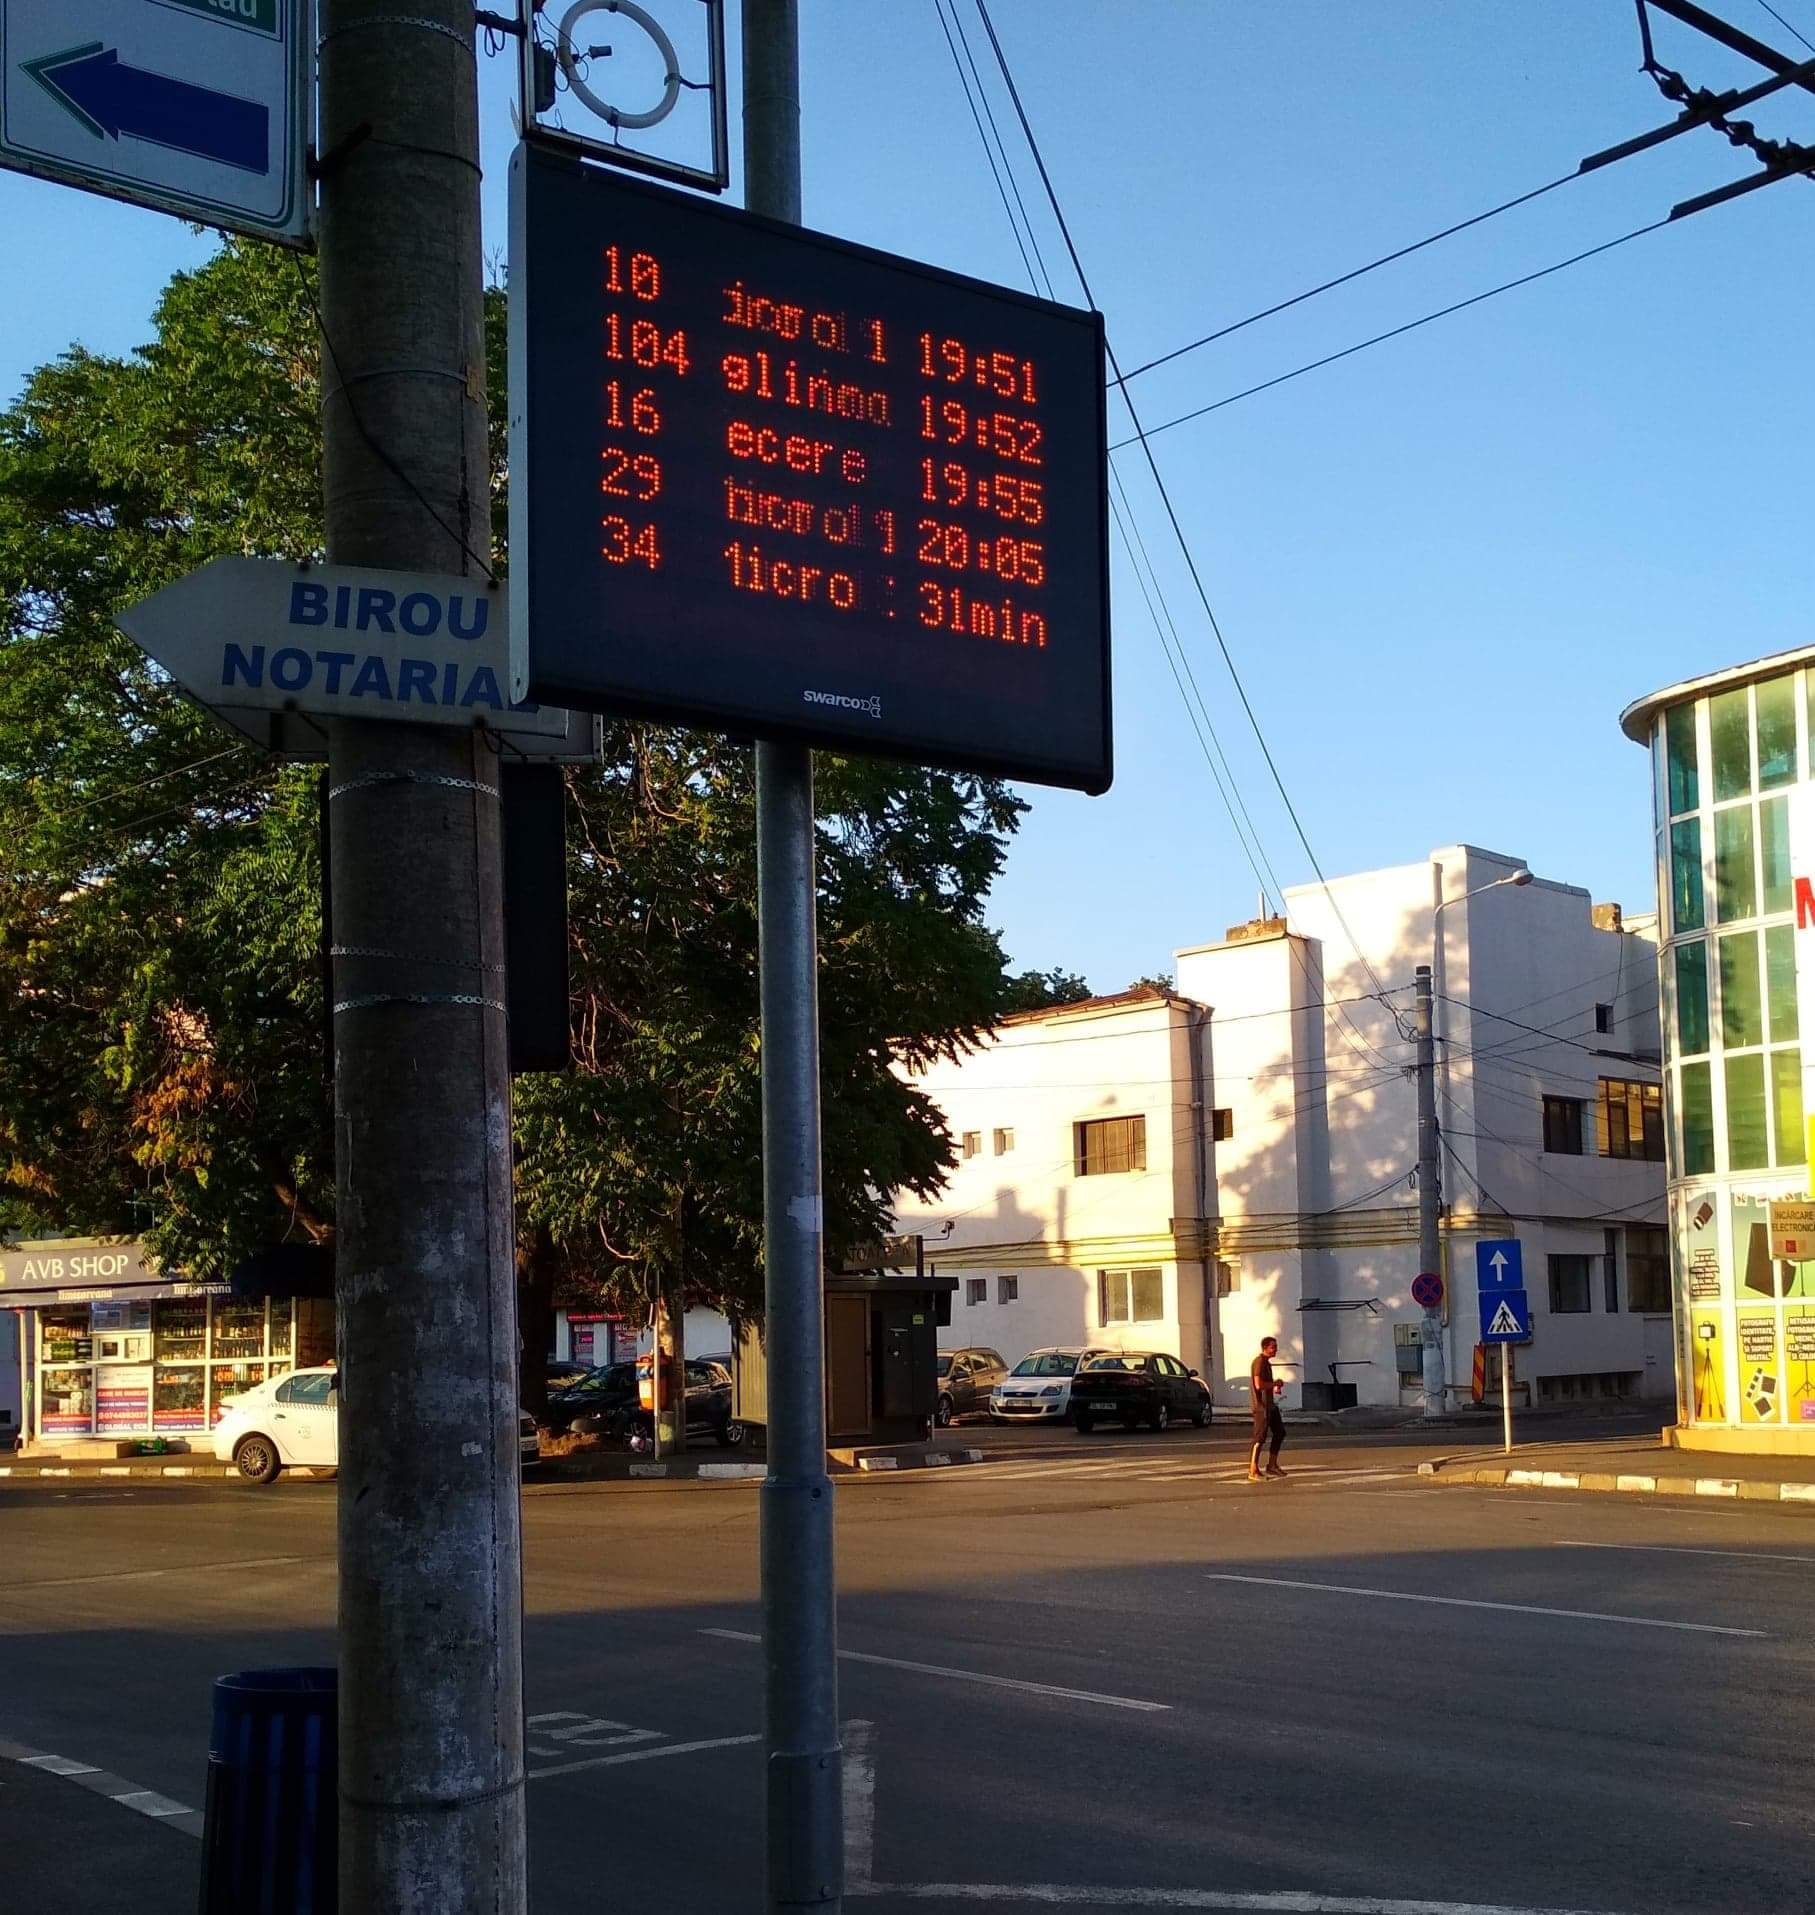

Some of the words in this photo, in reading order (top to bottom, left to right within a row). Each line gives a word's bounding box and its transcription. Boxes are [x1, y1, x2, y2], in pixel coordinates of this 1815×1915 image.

[605, 245, 661, 301] 10
[605, 312, 690, 376] 104
[919, 332, 1037, 404] 19:51
[606, 380, 661, 434] 16
[921, 457, 1044, 524] 19:55
[920, 394, 1043, 465] 19:52
[601, 447, 660, 501] 29
[601, 515, 660, 570] 34
[918, 581, 1046, 648] 31min
[917, 518, 1045, 585] 20:05
[288, 581, 490, 641] BIROU
[802, 690, 861, 709] swarco
[21, 1258, 64, 1281] AVB
[69, 1254, 129, 1278] SHOP
